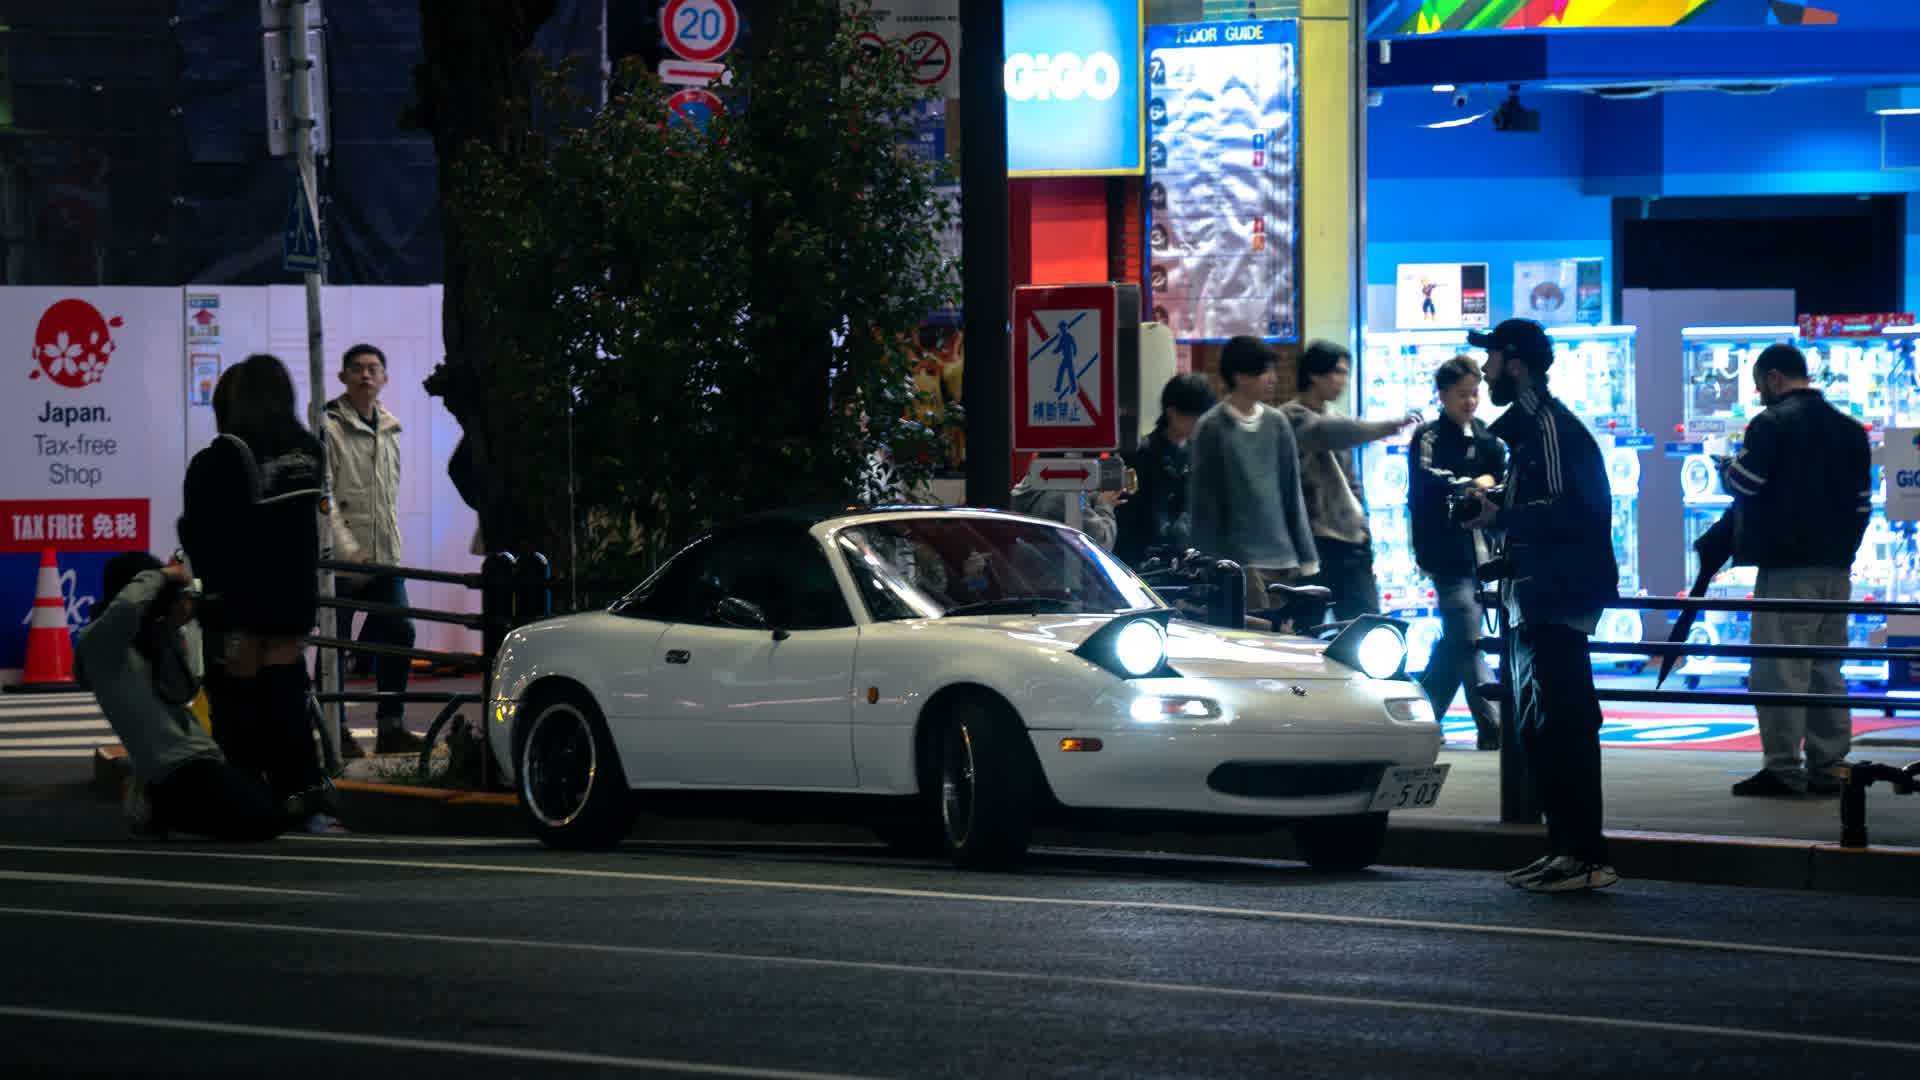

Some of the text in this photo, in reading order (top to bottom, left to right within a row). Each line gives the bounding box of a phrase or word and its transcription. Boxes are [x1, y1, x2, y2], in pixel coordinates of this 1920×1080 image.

[679, 7, 720, 41] 20
[1176, 25, 1264, 43] FLOOR GUIDE
[38, 402, 111, 427] Japan.
[34, 433, 117, 456] Tax-free
[50, 463, 102, 488] Shop
[12, 512, 137, 540] TAX FREE 免税
